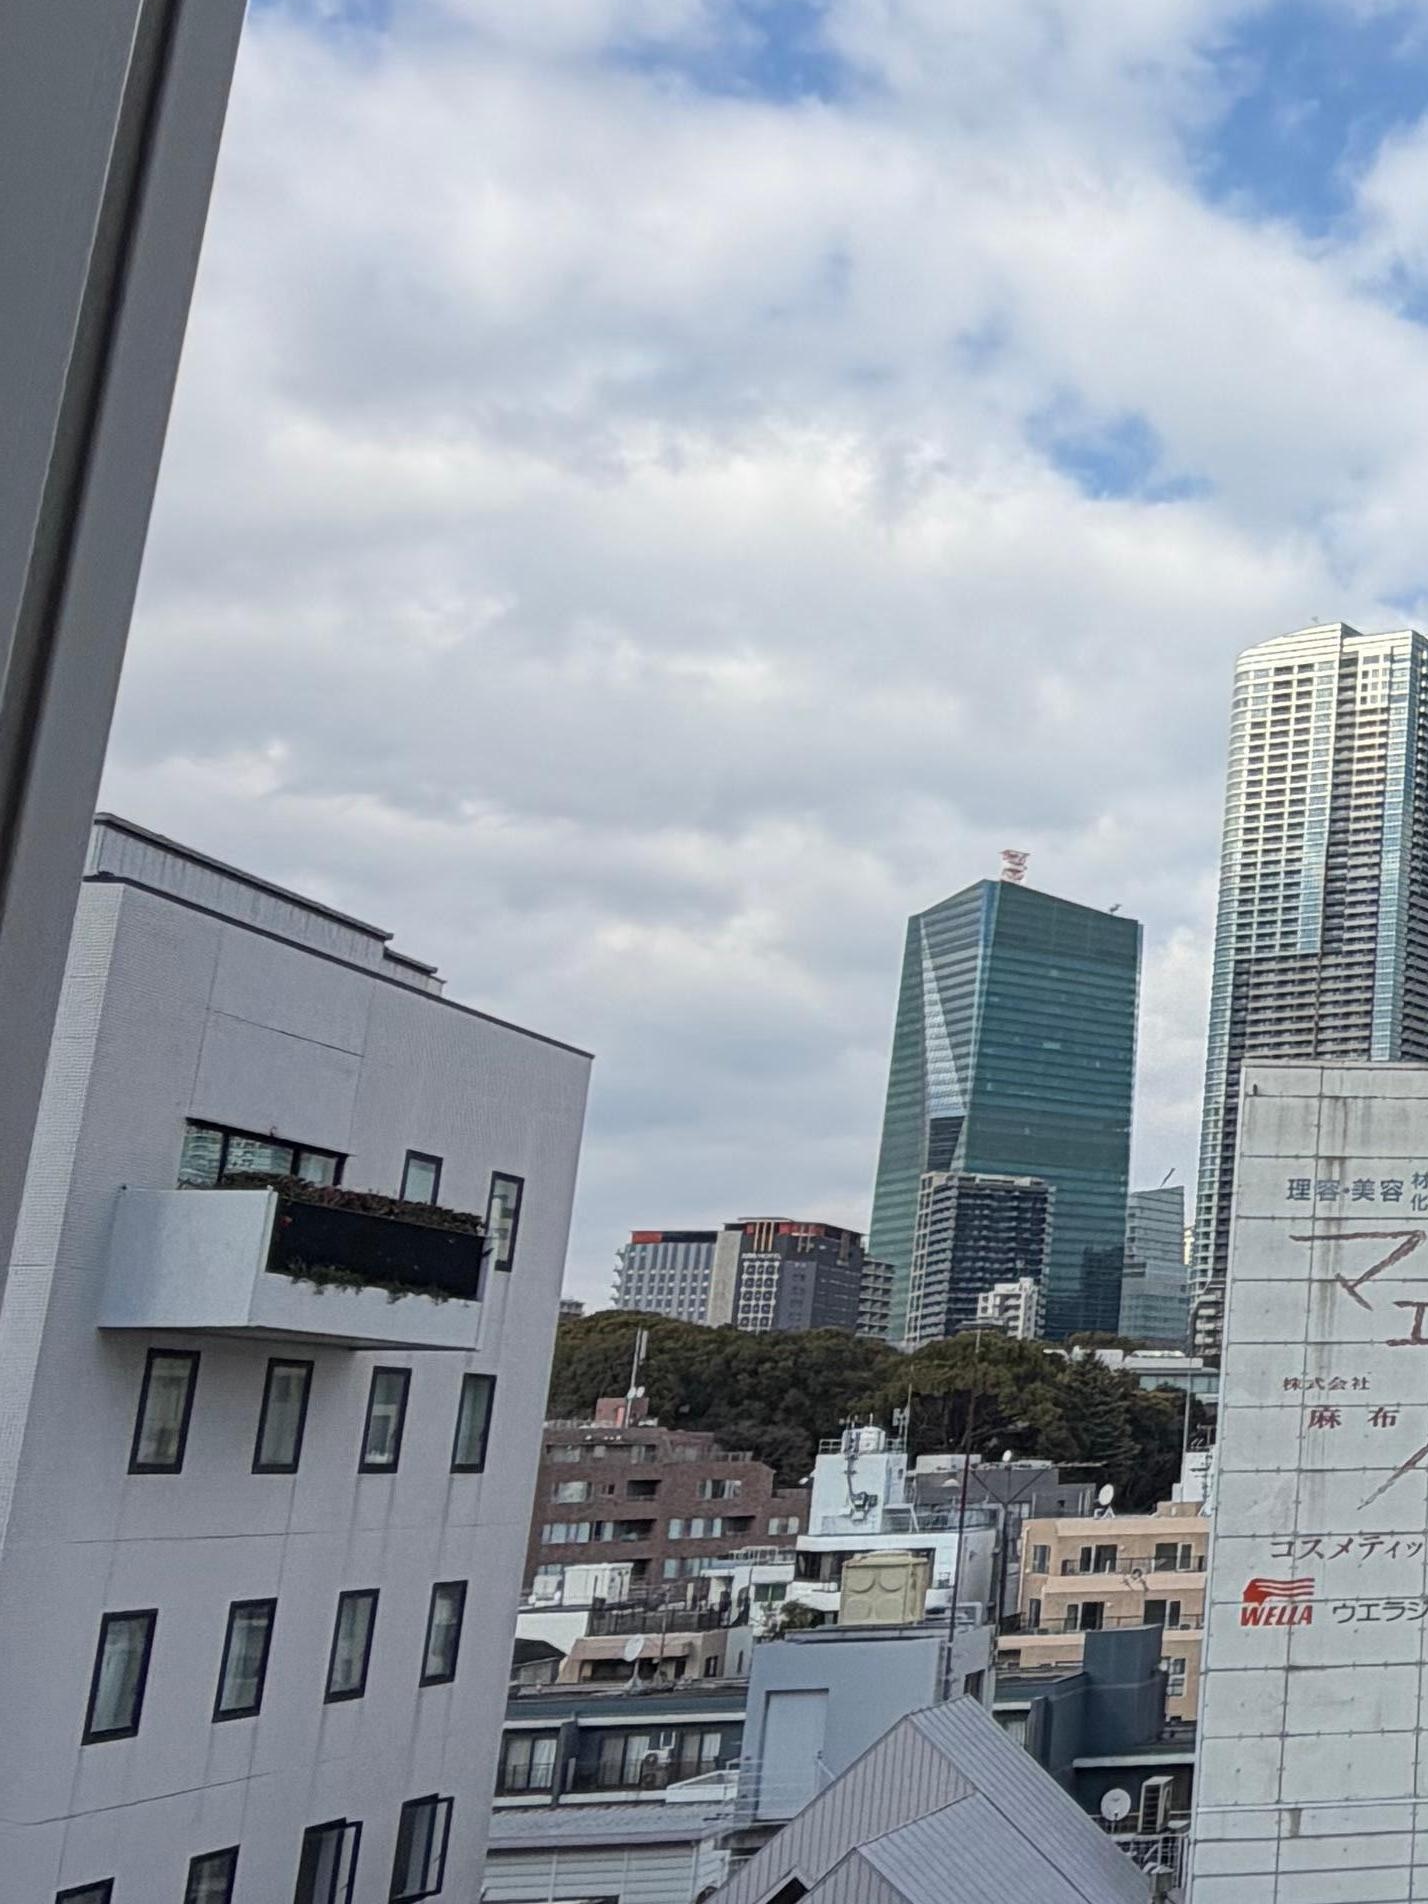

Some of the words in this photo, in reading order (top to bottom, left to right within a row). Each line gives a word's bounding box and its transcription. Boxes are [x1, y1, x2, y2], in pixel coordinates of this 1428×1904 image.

[1283, 1376, 1371, 1392] 株式会社
[1240, 1604, 1314, 1627] WELLA
